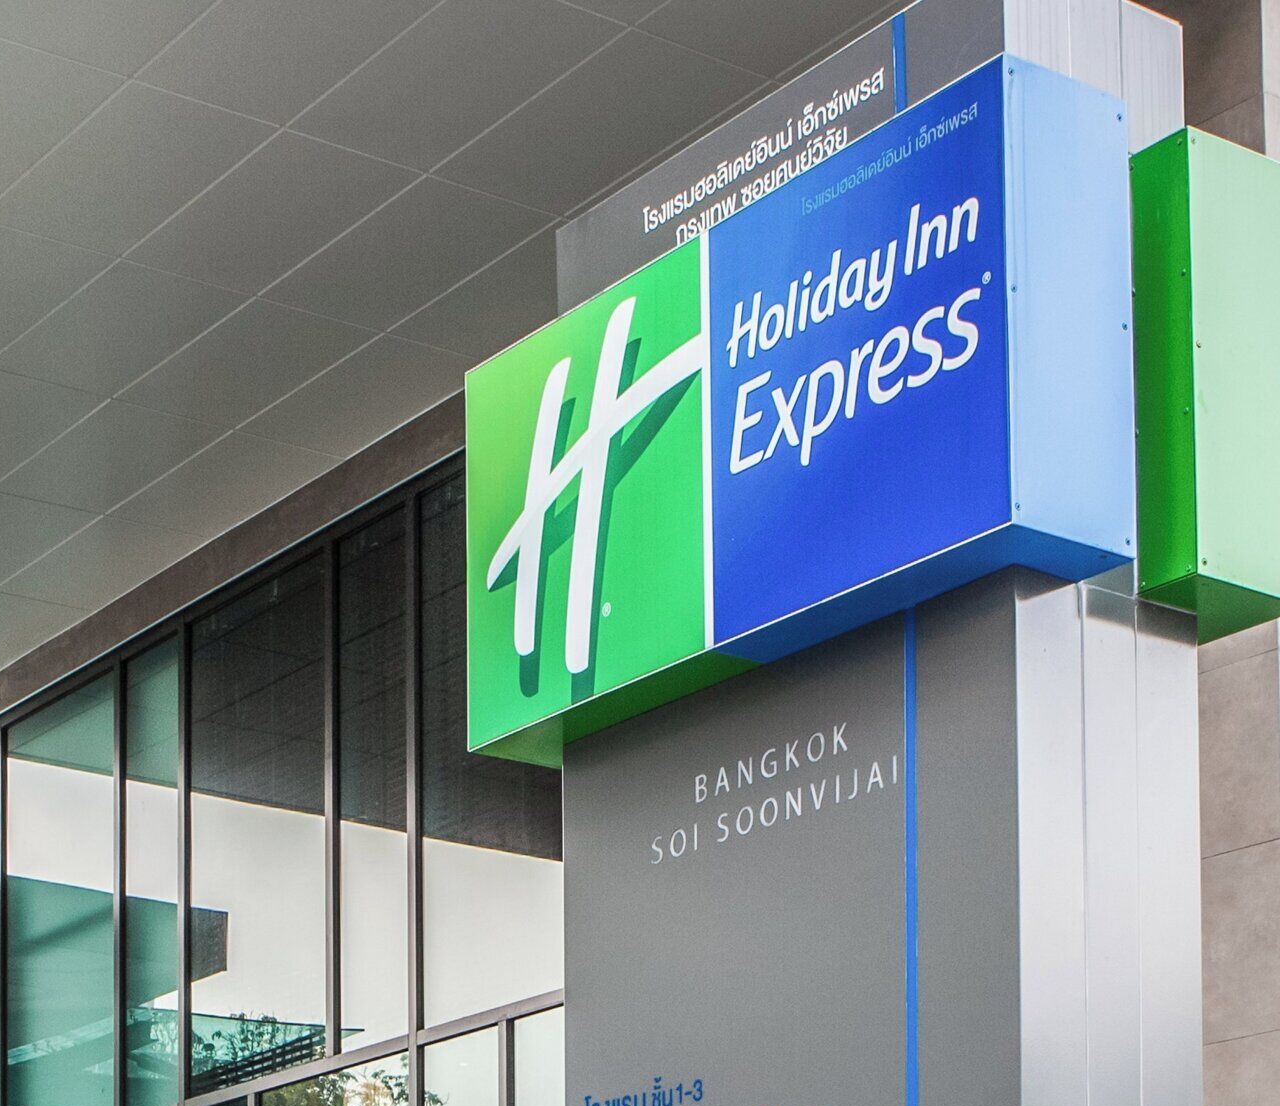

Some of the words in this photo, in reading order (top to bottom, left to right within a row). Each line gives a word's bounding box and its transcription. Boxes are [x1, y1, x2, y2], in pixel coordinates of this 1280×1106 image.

[797, 67, 885, 141] เอ็กซ์เพรส
[675, 193, 736, 247] กรงเทพ
[741, 126, 848, 207] ซอยศนย์วิจัย
[726, 239, 898, 368] Holiday
[904, 197, 979, 276] Inn
[730, 287, 982, 475] Express
[651, 823, 698, 864] SOI
[716, 755, 898, 843] SOONVIJAI
[694, 722, 848, 803] BANGKOK
